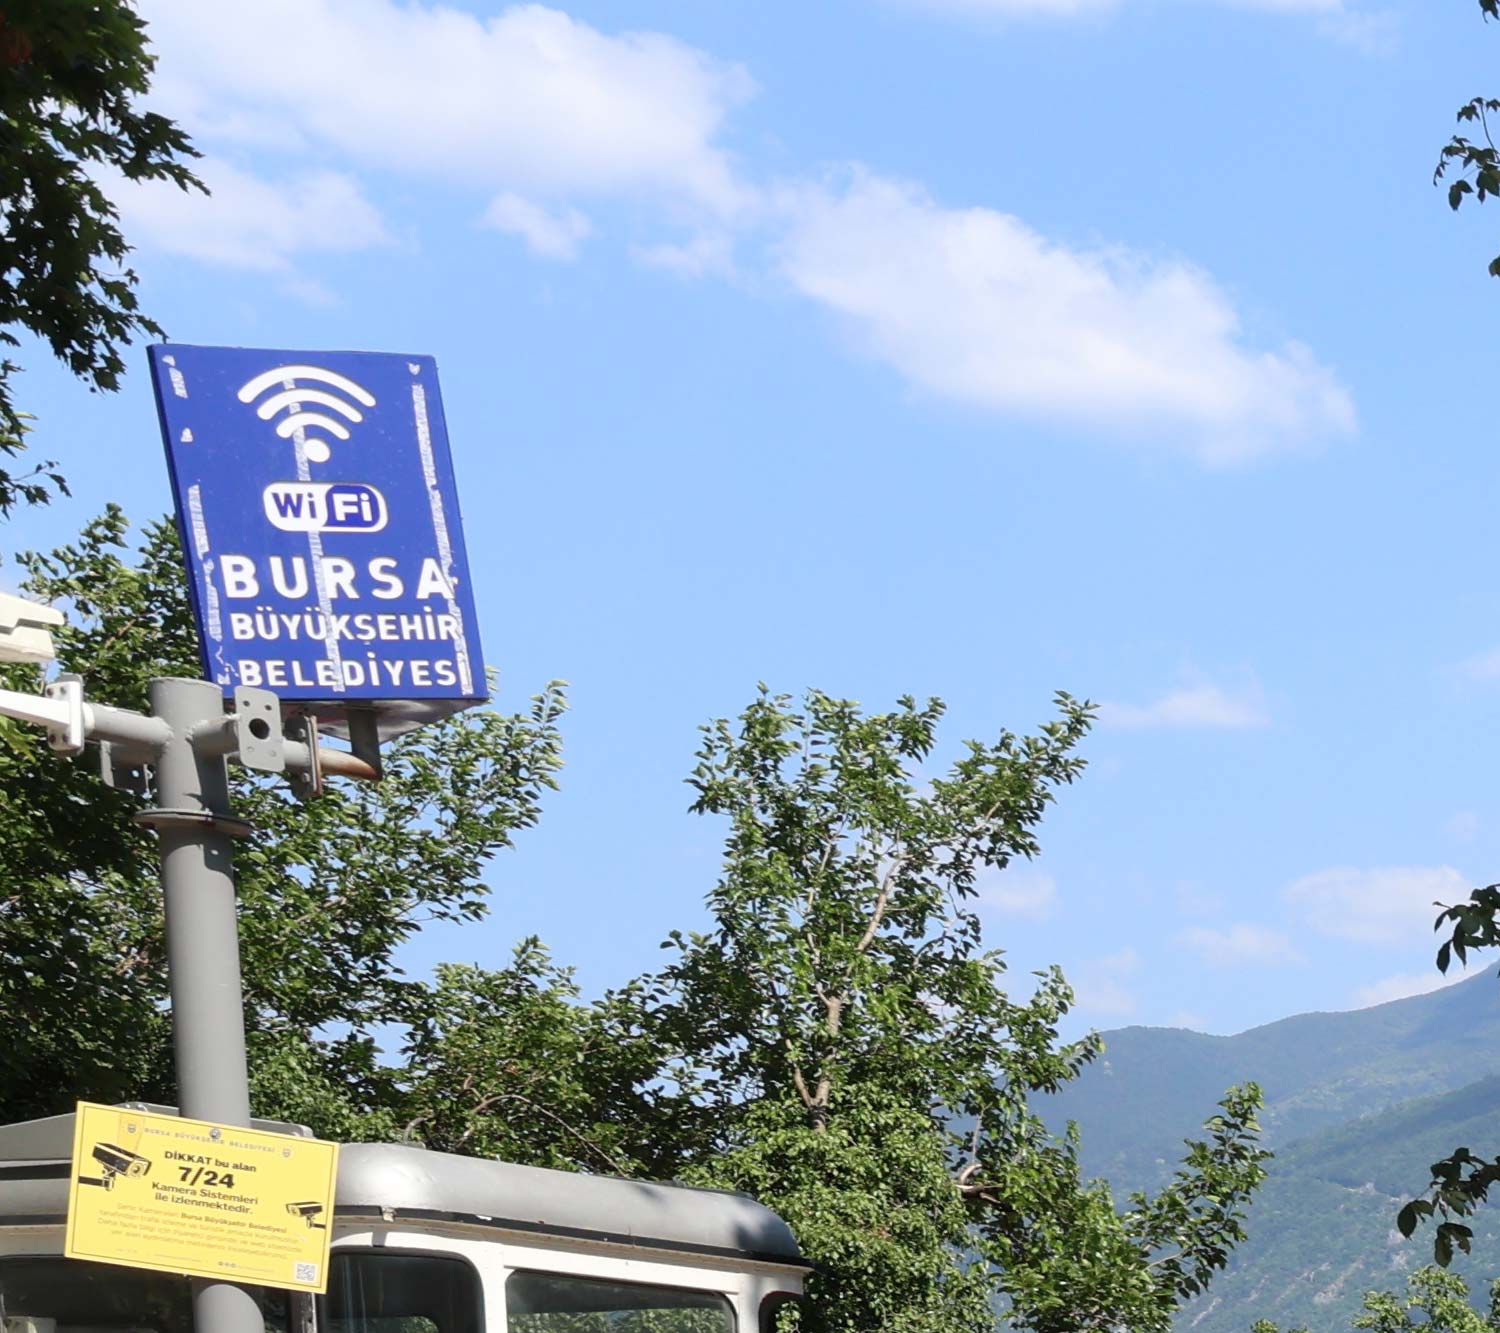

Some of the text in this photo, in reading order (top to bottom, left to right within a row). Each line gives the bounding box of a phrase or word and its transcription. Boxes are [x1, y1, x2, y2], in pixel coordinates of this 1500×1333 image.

[220, 554, 455, 599] BURSA
[164, 1150, 257, 1172] DİKKAT bu alan
[178, 1166, 234, 1188] 7/24
[152, 1182, 258, 1205] Kamera Sistemleri
[155, 1192, 253, 1214] ile izlenmektedir.
